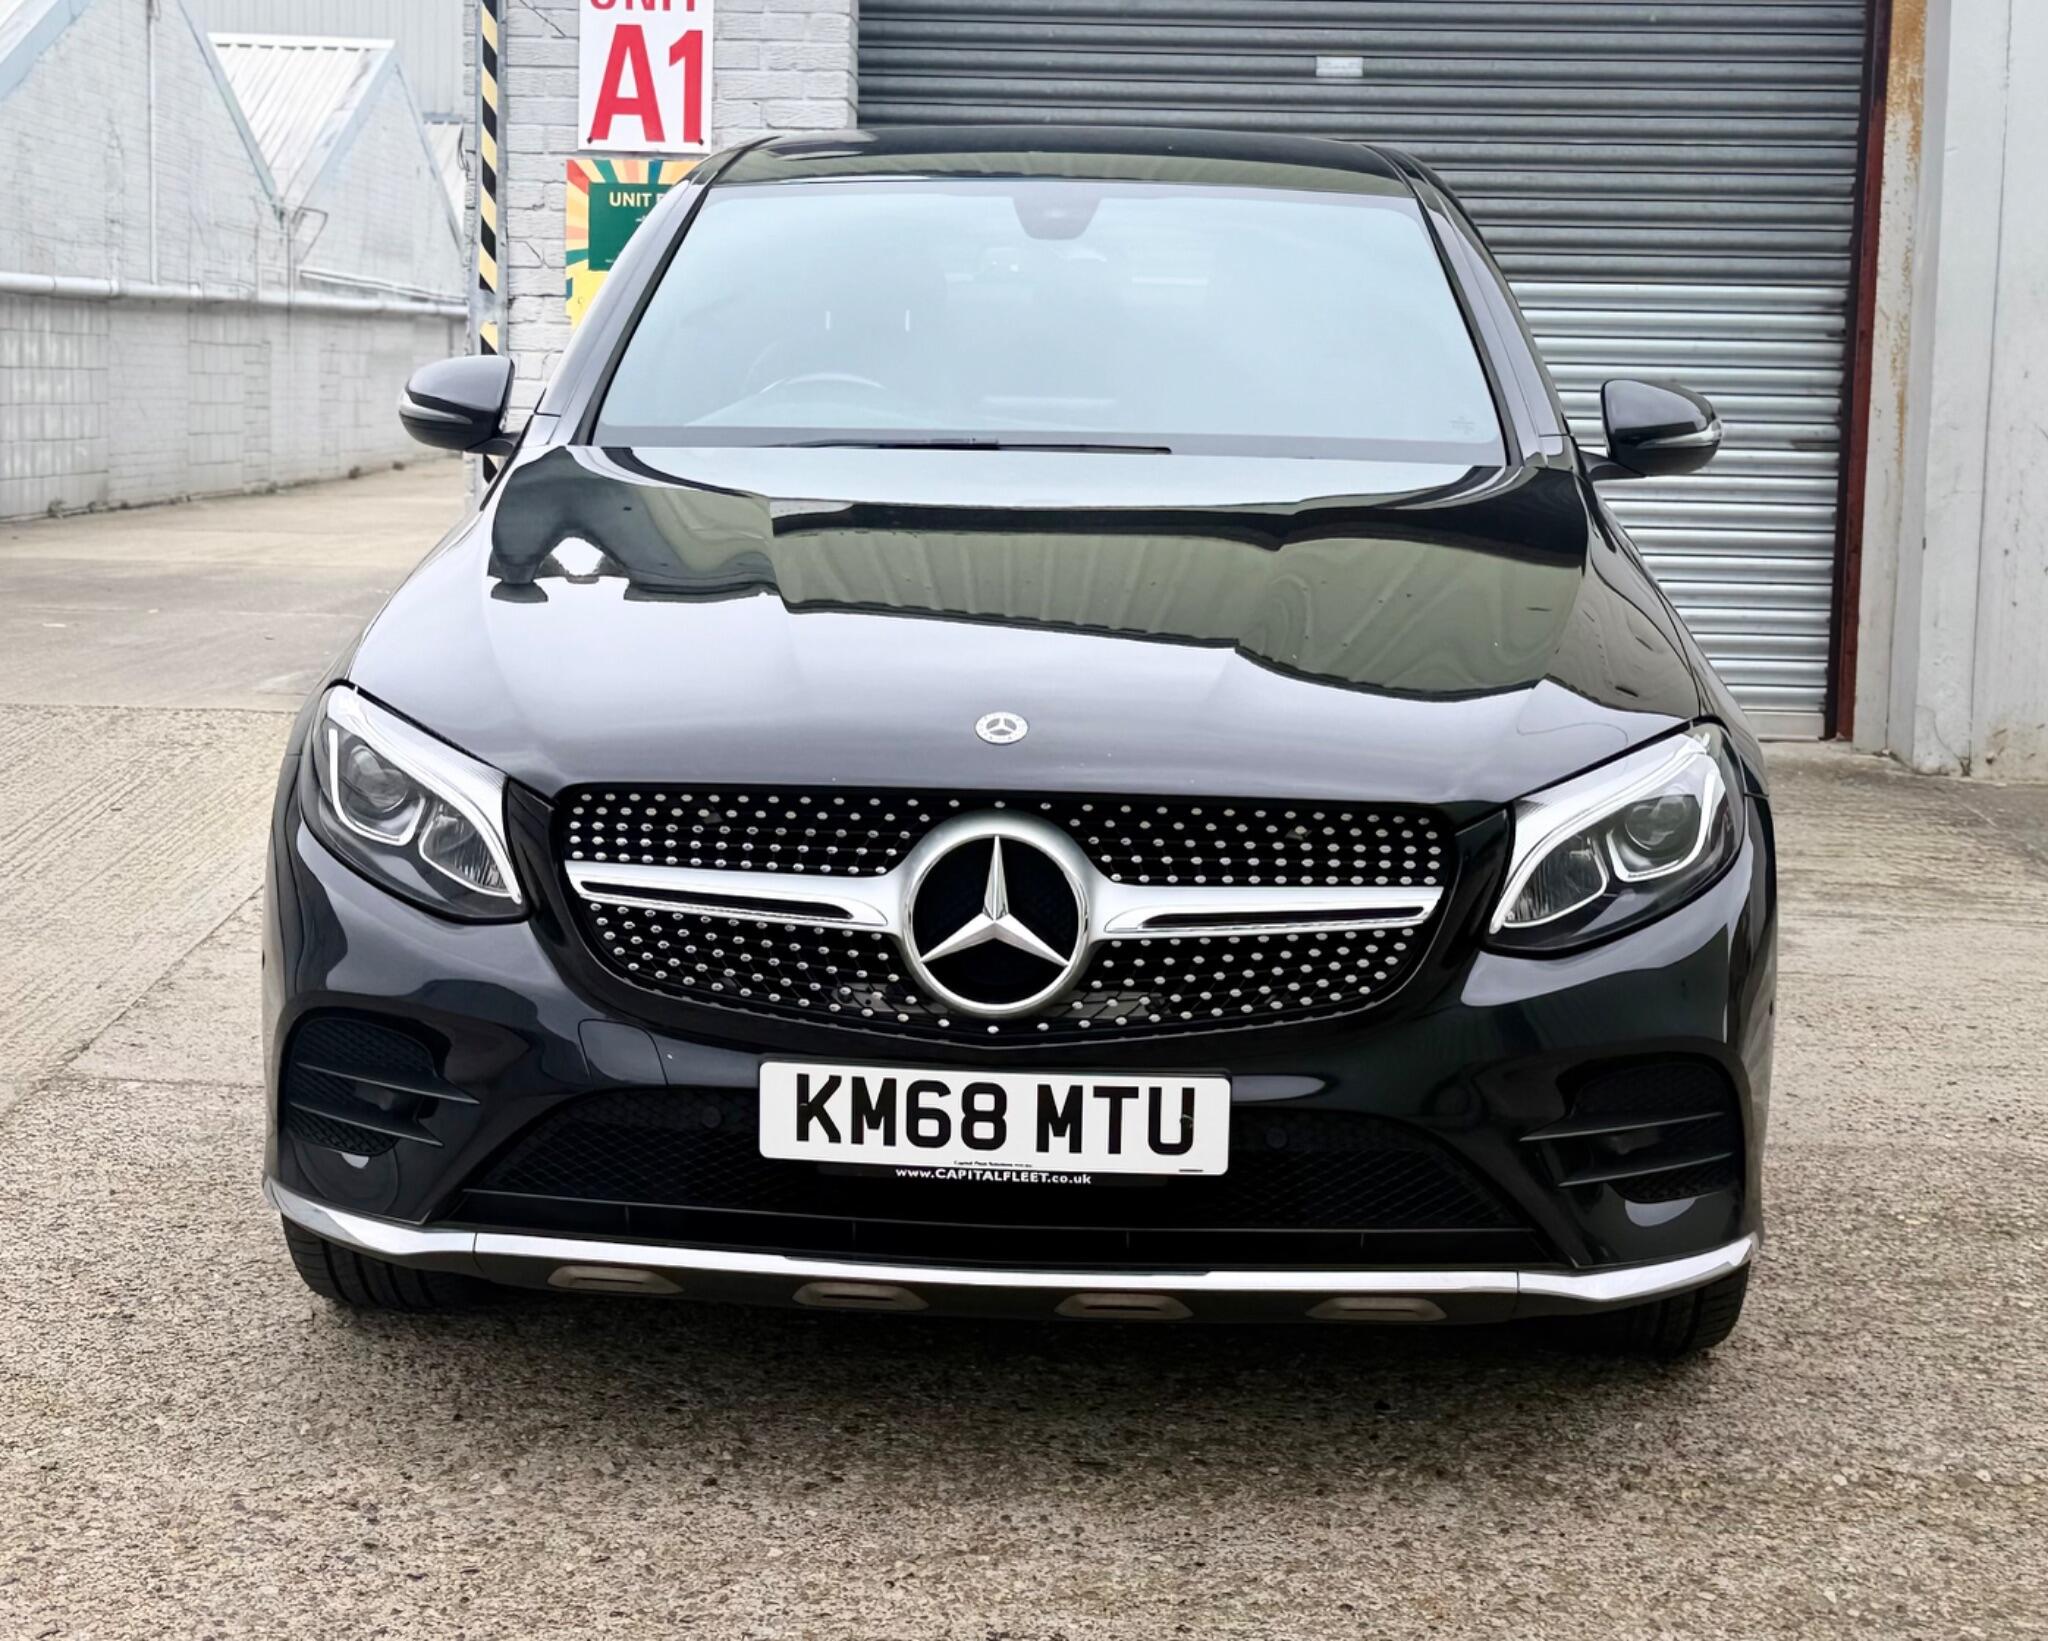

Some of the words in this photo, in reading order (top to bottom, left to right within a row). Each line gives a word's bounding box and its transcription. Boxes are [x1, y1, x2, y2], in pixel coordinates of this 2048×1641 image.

[590, 24, 703, 143] A1
[609, 191, 652, 207] UNIT
[796, 1073, 1007, 1151] KM68
[1036, 1084, 1195, 1156] MTU
[896, 1168, 1091, 1184] www.CAPITALFLEET.co.uk
